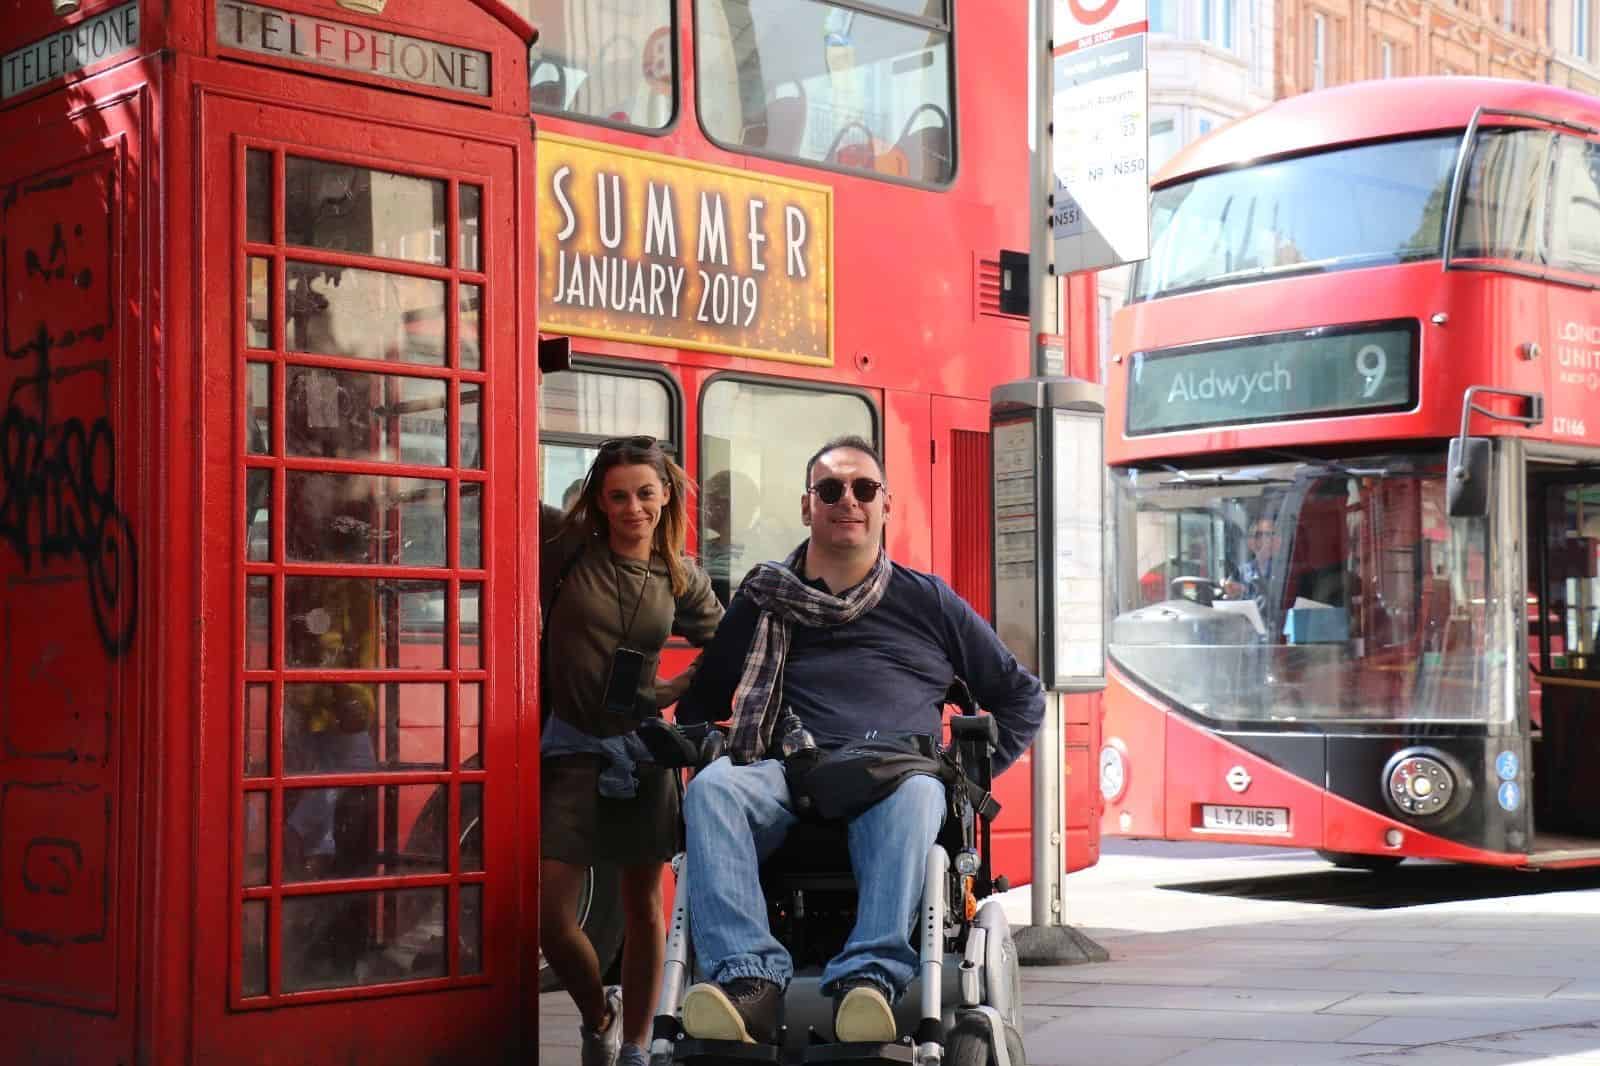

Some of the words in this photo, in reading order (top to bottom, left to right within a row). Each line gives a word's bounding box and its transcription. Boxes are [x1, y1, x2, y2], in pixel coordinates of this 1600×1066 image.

[7, 6, 137, 92] TELEPHONE
[221, 9, 479, 90] TELEPHONE
[1113, 158, 1145, 177] N550
[552, 165, 807, 278] SUMMER
[1055, 209, 1081, 226] N551
[553, 249, 685, 319] JANUARY
[696, 269, 759, 328] 2019
[1167, 363, 1293, 404] Aldwych
[1355, 344, 1387, 398] 9
[1215, 808, 1244, 825] LTZ
[1246, 811, 1276, 826] 1166
